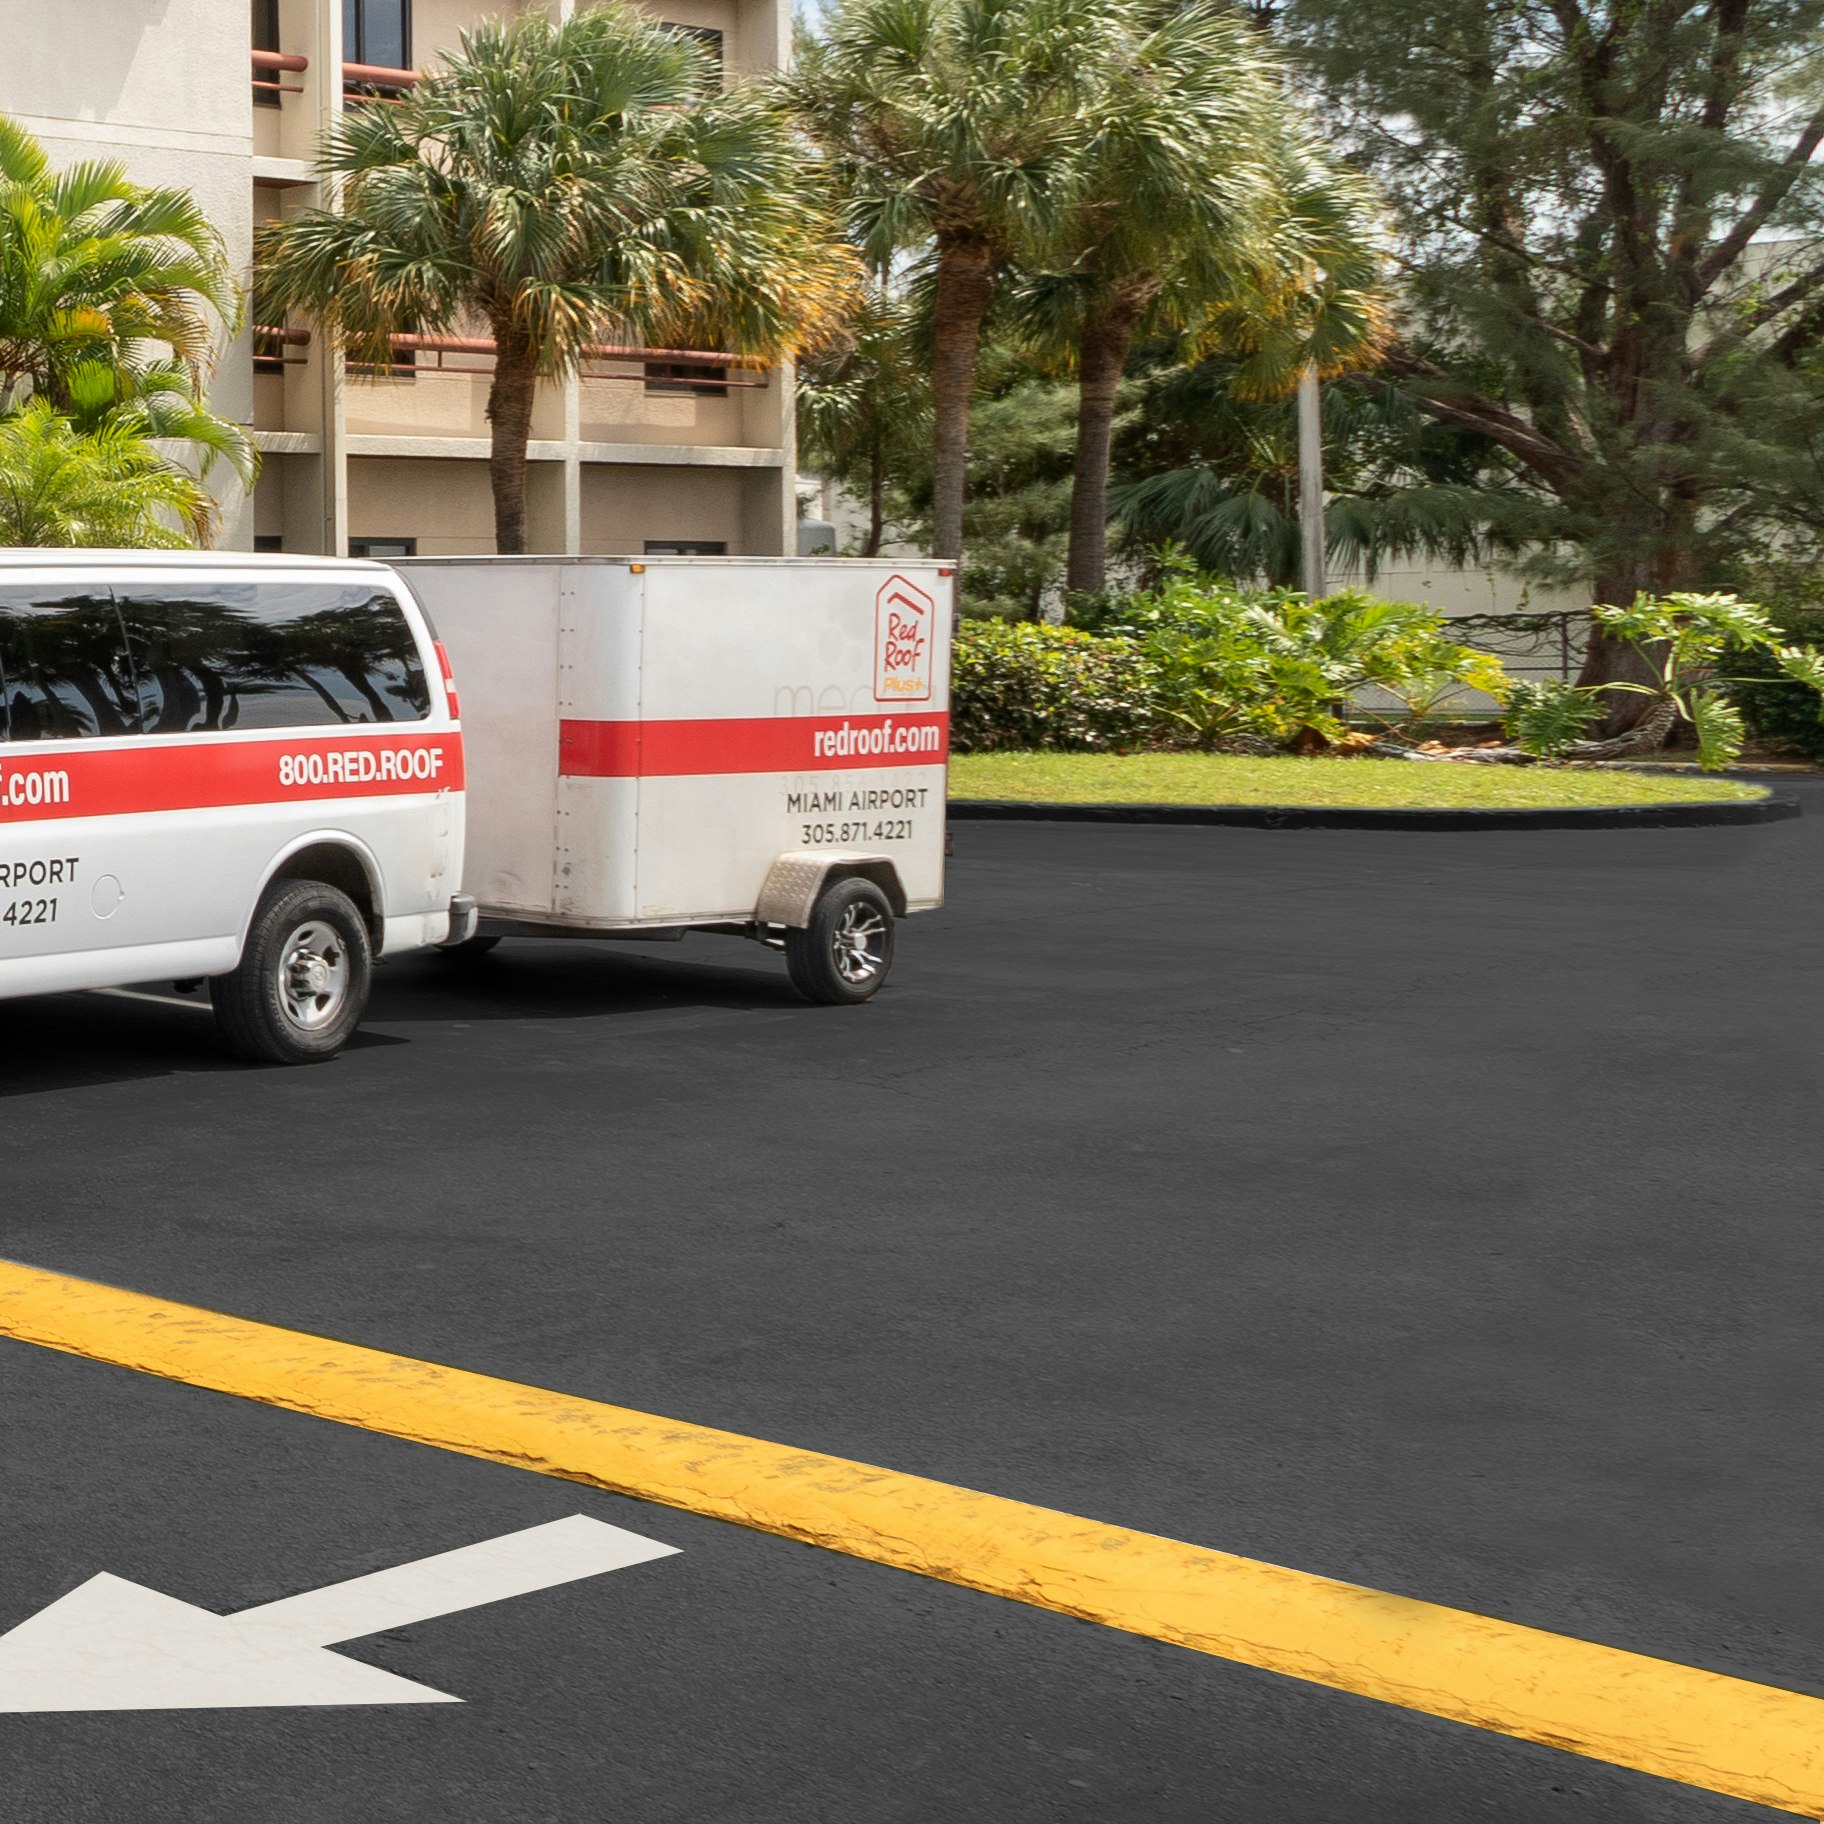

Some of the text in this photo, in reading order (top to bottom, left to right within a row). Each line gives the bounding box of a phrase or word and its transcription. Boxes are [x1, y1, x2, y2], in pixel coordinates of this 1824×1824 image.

[888, 612, 919, 642] Red
[884, 637, 925, 673] Roof
[883, 676, 923, 693] Plus+
[813, 719, 940, 757] redroof.com
[279, 748, 444, 786] 800.RED.ROOF
[787, 788, 929, 814] MIAMI AIRPORT
[802, 819, 913, 845] 305.871.4221
